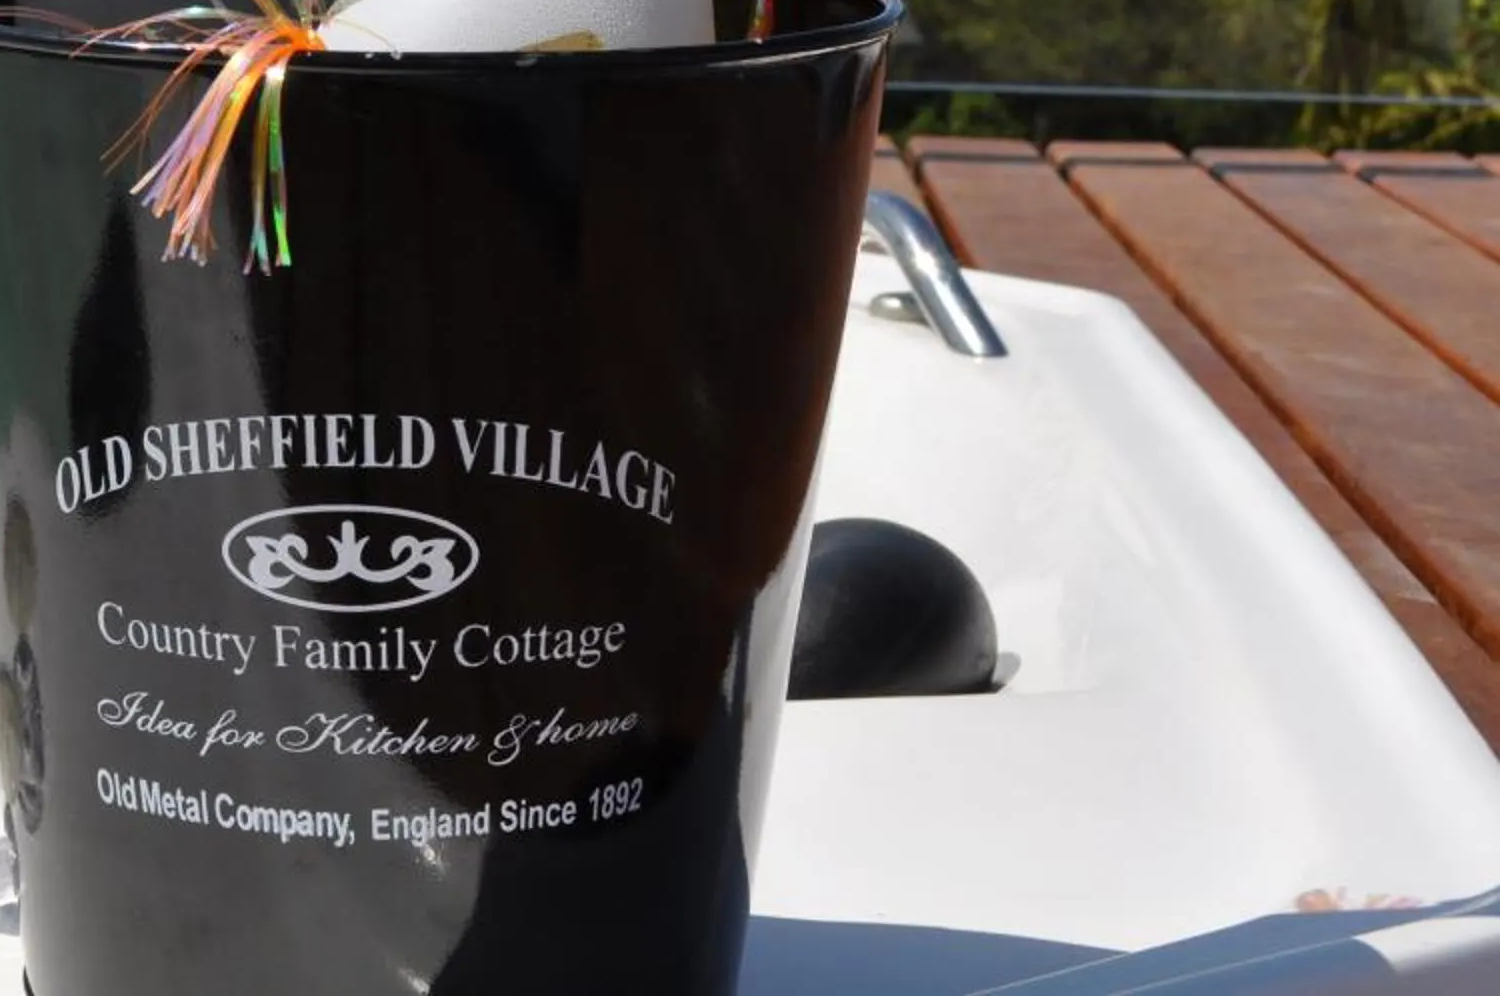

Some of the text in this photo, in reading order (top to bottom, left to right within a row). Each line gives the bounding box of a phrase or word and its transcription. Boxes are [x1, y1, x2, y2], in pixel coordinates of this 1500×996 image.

[55, 414, 677, 524] OLD SHEFFIELD VILLAGE
[97, 601, 627, 681] Country Family Cottage
[97, 690, 197, 739] Idea
[199, 709, 266, 756] for
[275, 712, 479, 756] Kitchen
[214, 794, 356, 847] Company,
[371, 803, 490, 848] England
[500, 799, 577, 833] Since
[588, 777, 644, 822] 1892
